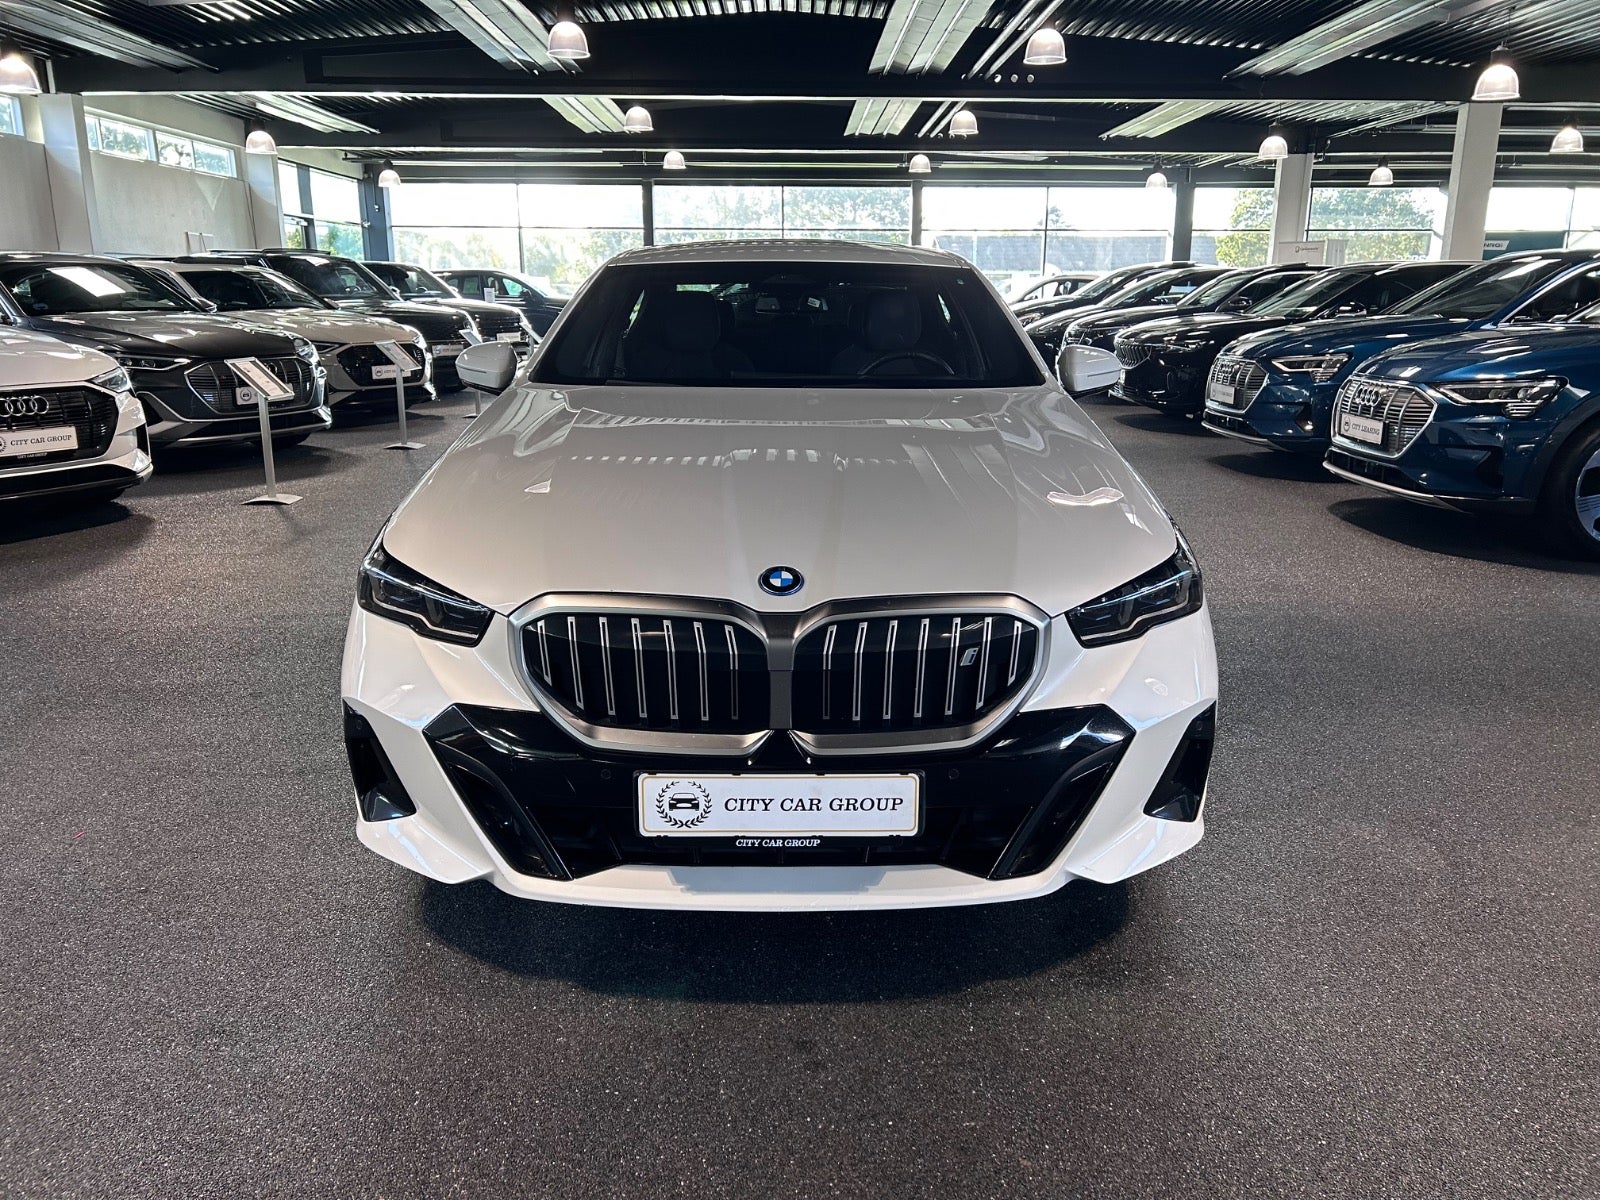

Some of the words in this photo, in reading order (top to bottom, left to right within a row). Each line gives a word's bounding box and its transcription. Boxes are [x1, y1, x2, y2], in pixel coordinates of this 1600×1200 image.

[10, 438, 29, 446] CITY
[46, 434, 72, 443] GROUP
[724, 797, 774, 812] CITY
[780, 797, 822, 812] CAR
[829, 797, 904, 812] GROUP
[735, 838, 761, 847] CITY
[762, 838, 783, 847] CAR
[784, 838, 820, 847] GROUP
